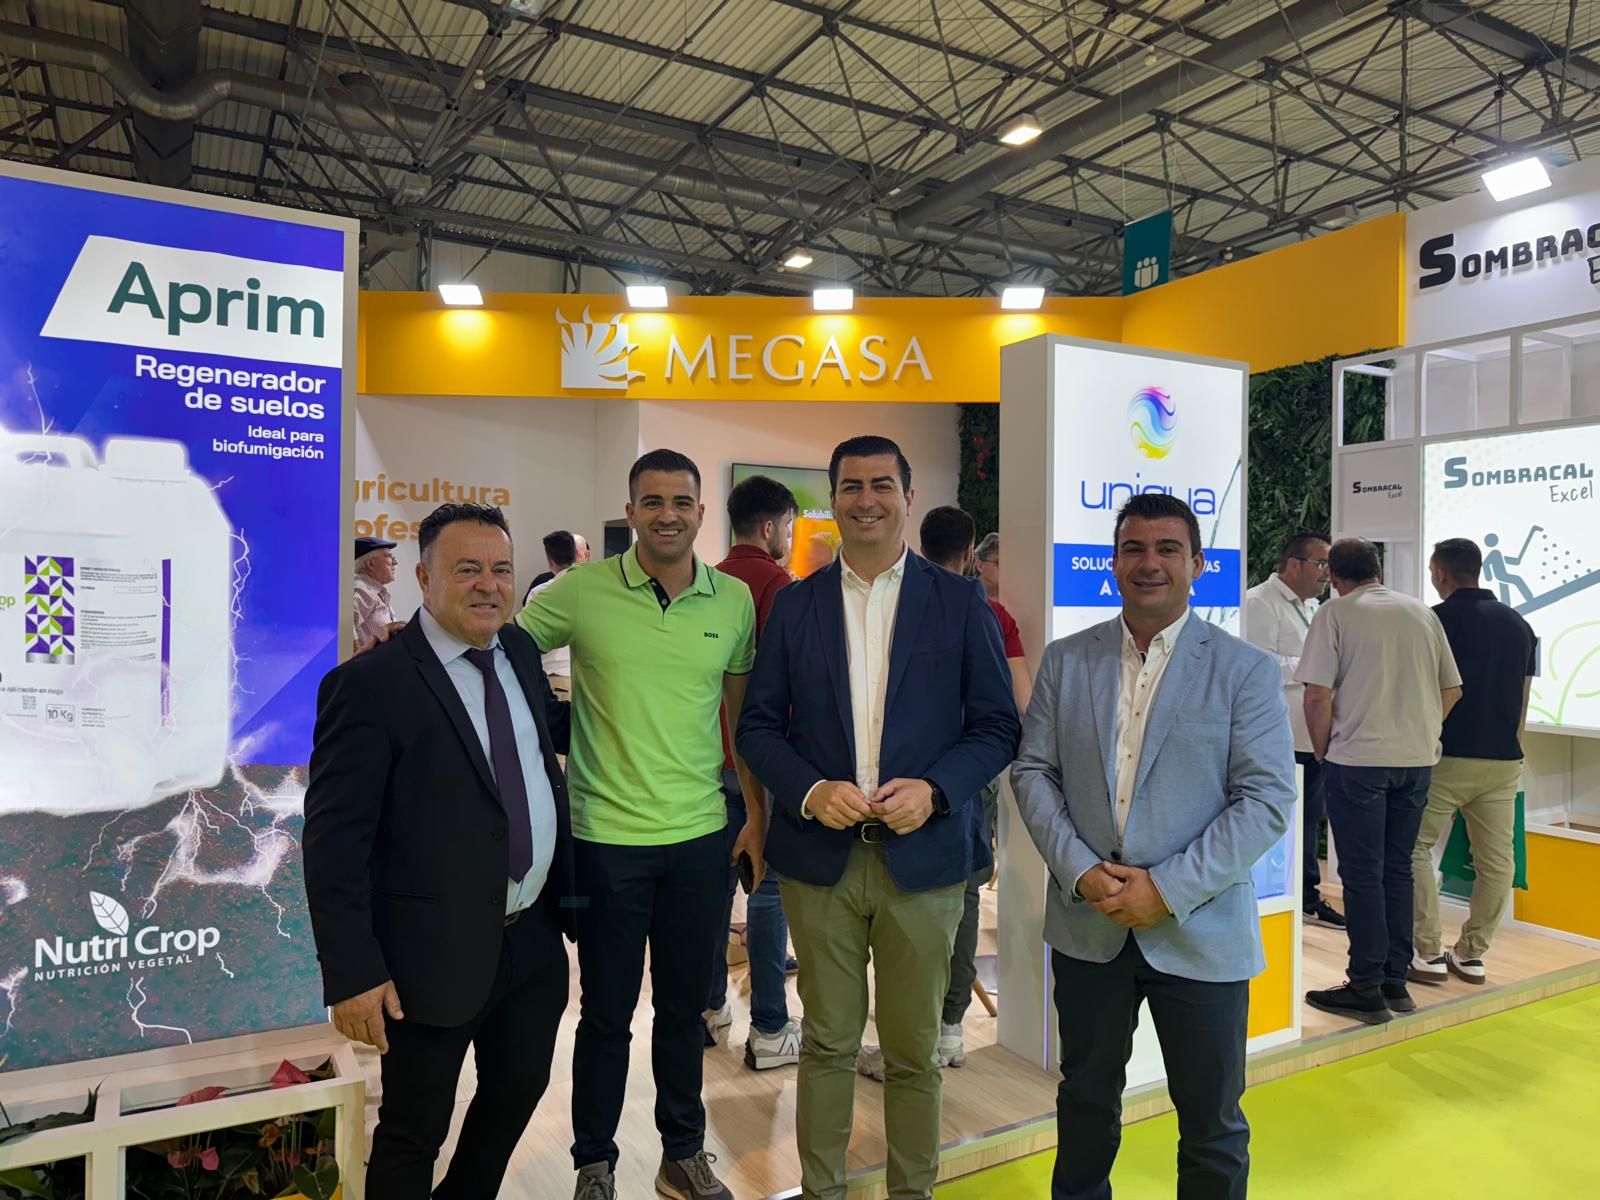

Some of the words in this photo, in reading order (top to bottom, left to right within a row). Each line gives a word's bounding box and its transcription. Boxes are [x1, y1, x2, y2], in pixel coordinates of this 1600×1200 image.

[106, 261, 326, 339] Aprim
[664, 333, 934, 383] MEGASA
[135, 354, 327, 394] Regenerador
[184, 388, 222, 410] de
[230, 393, 325, 420] suelos
[247, 424, 287, 441] Ideal
[290, 430, 325, 445] para
[212, 439, 325, 460] biofumigación
[1549, 479, 1594, 503] Excel
[355, 513, 420, 541] ofes
[1071, 556, 1114, 571] SOLUC
[703, 631, 719, 639] BOSS
[47, 709, 59, 719] 10
[60, 710, 74, 723] Kg
[34, 962, 121, 982] NUTRICIÓN
[127, 954, 193, 971] VEGETAL
